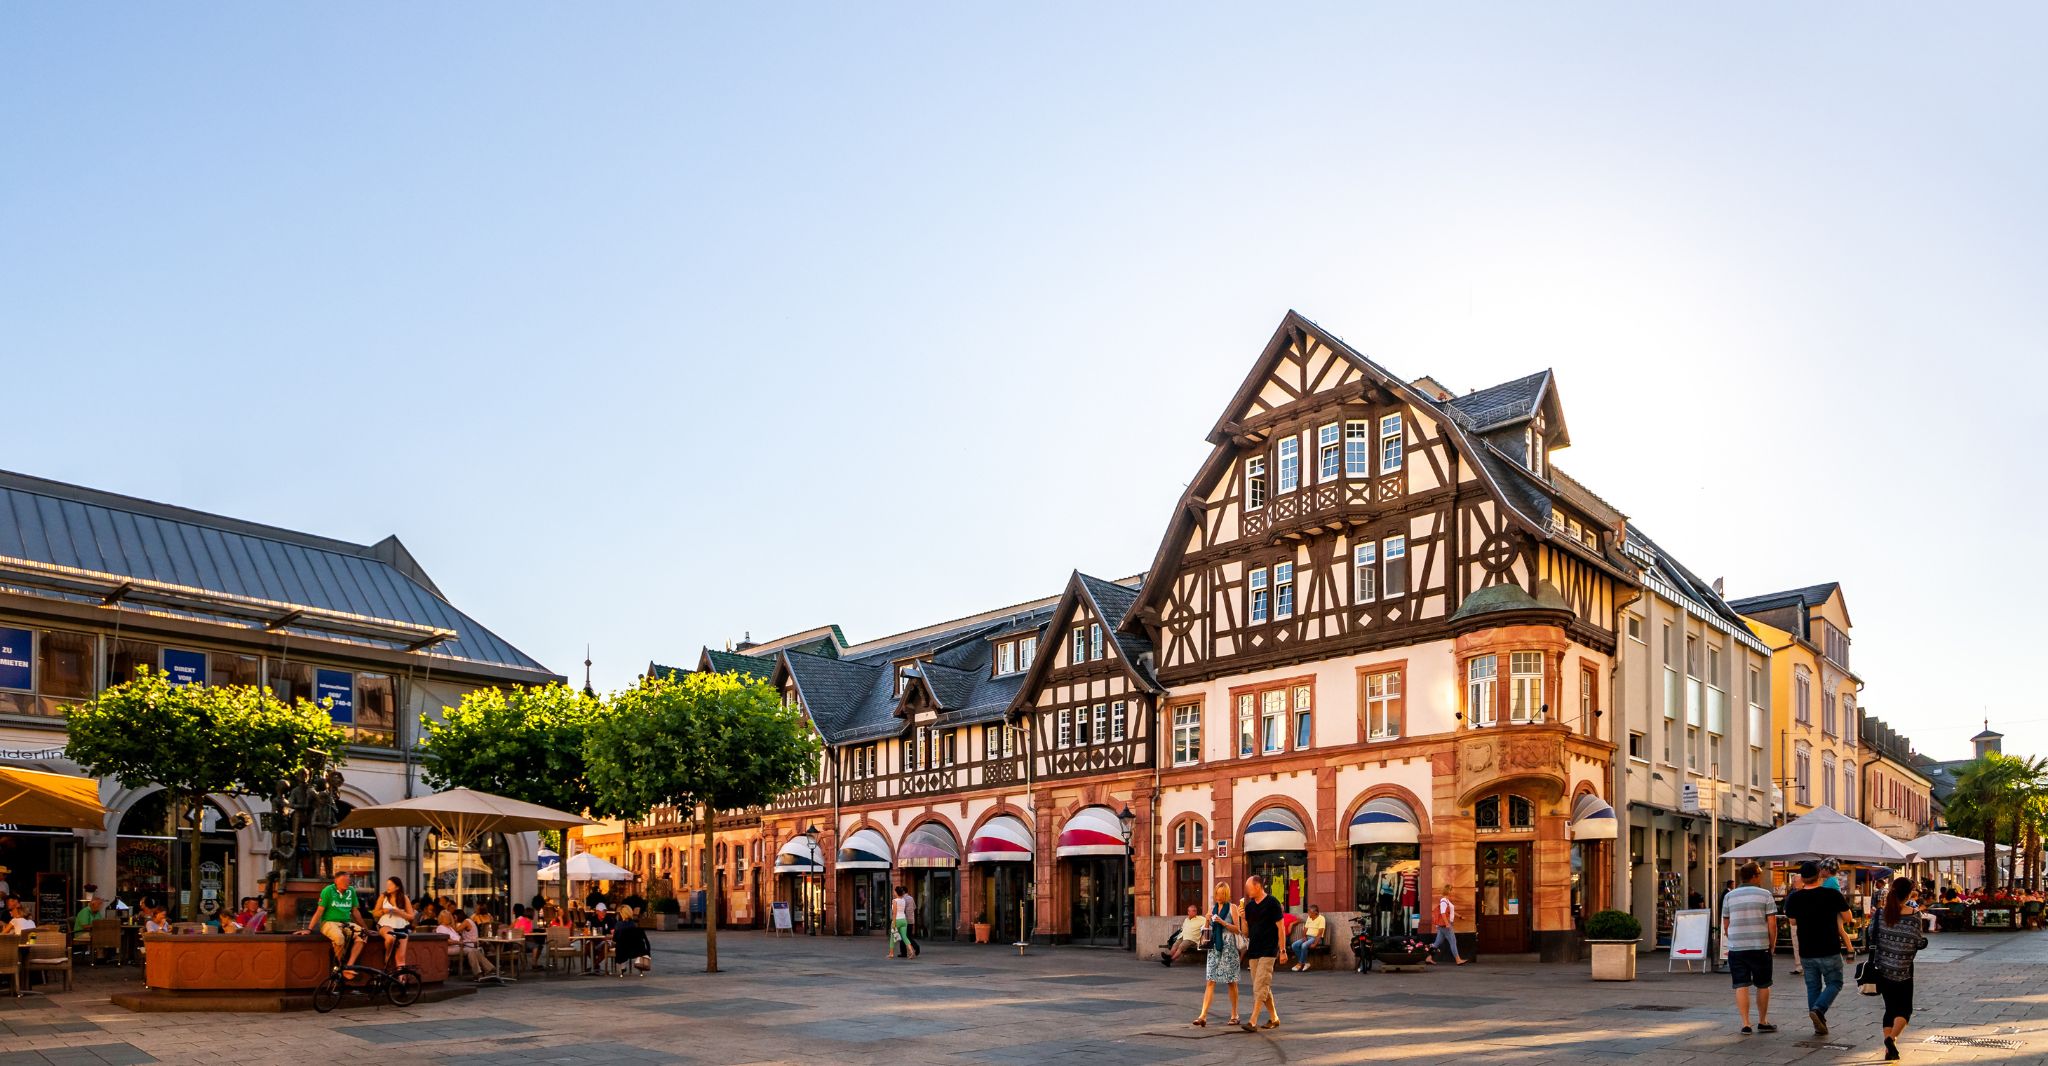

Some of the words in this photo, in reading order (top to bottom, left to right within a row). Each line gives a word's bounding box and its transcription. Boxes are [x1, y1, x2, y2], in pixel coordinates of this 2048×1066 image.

[2, 646, 13, 654] ZU
[174, 665, 196, 673] DIREKT
[345, 889, 352, 900] 2
